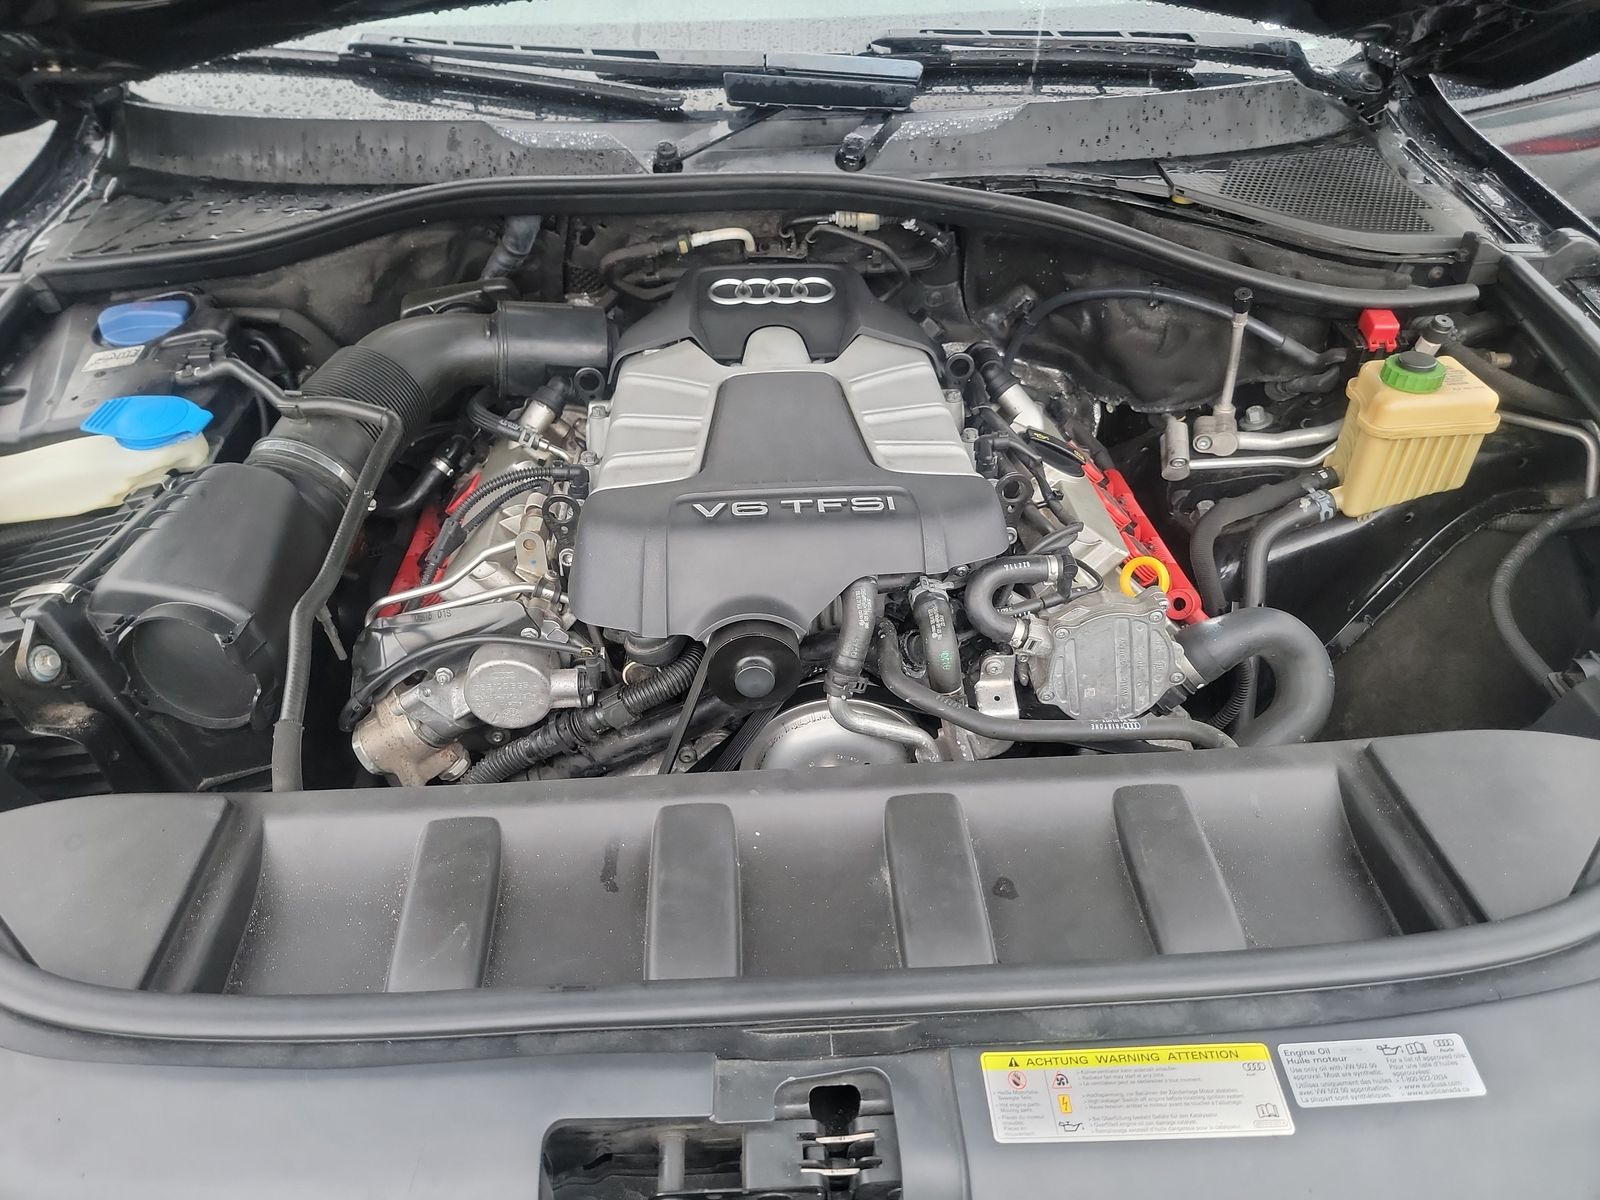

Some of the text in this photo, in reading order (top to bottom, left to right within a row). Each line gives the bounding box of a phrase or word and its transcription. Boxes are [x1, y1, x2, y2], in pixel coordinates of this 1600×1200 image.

[692, 496, 896, 518] V6 TFSI
[1026, 1050, 1240, 1067] ACHTUNG WARNING ATTENTION
[1283, 1048, 1315, 1058] Engine
[1286, 1056, 1348, 1065] Huile moteur
